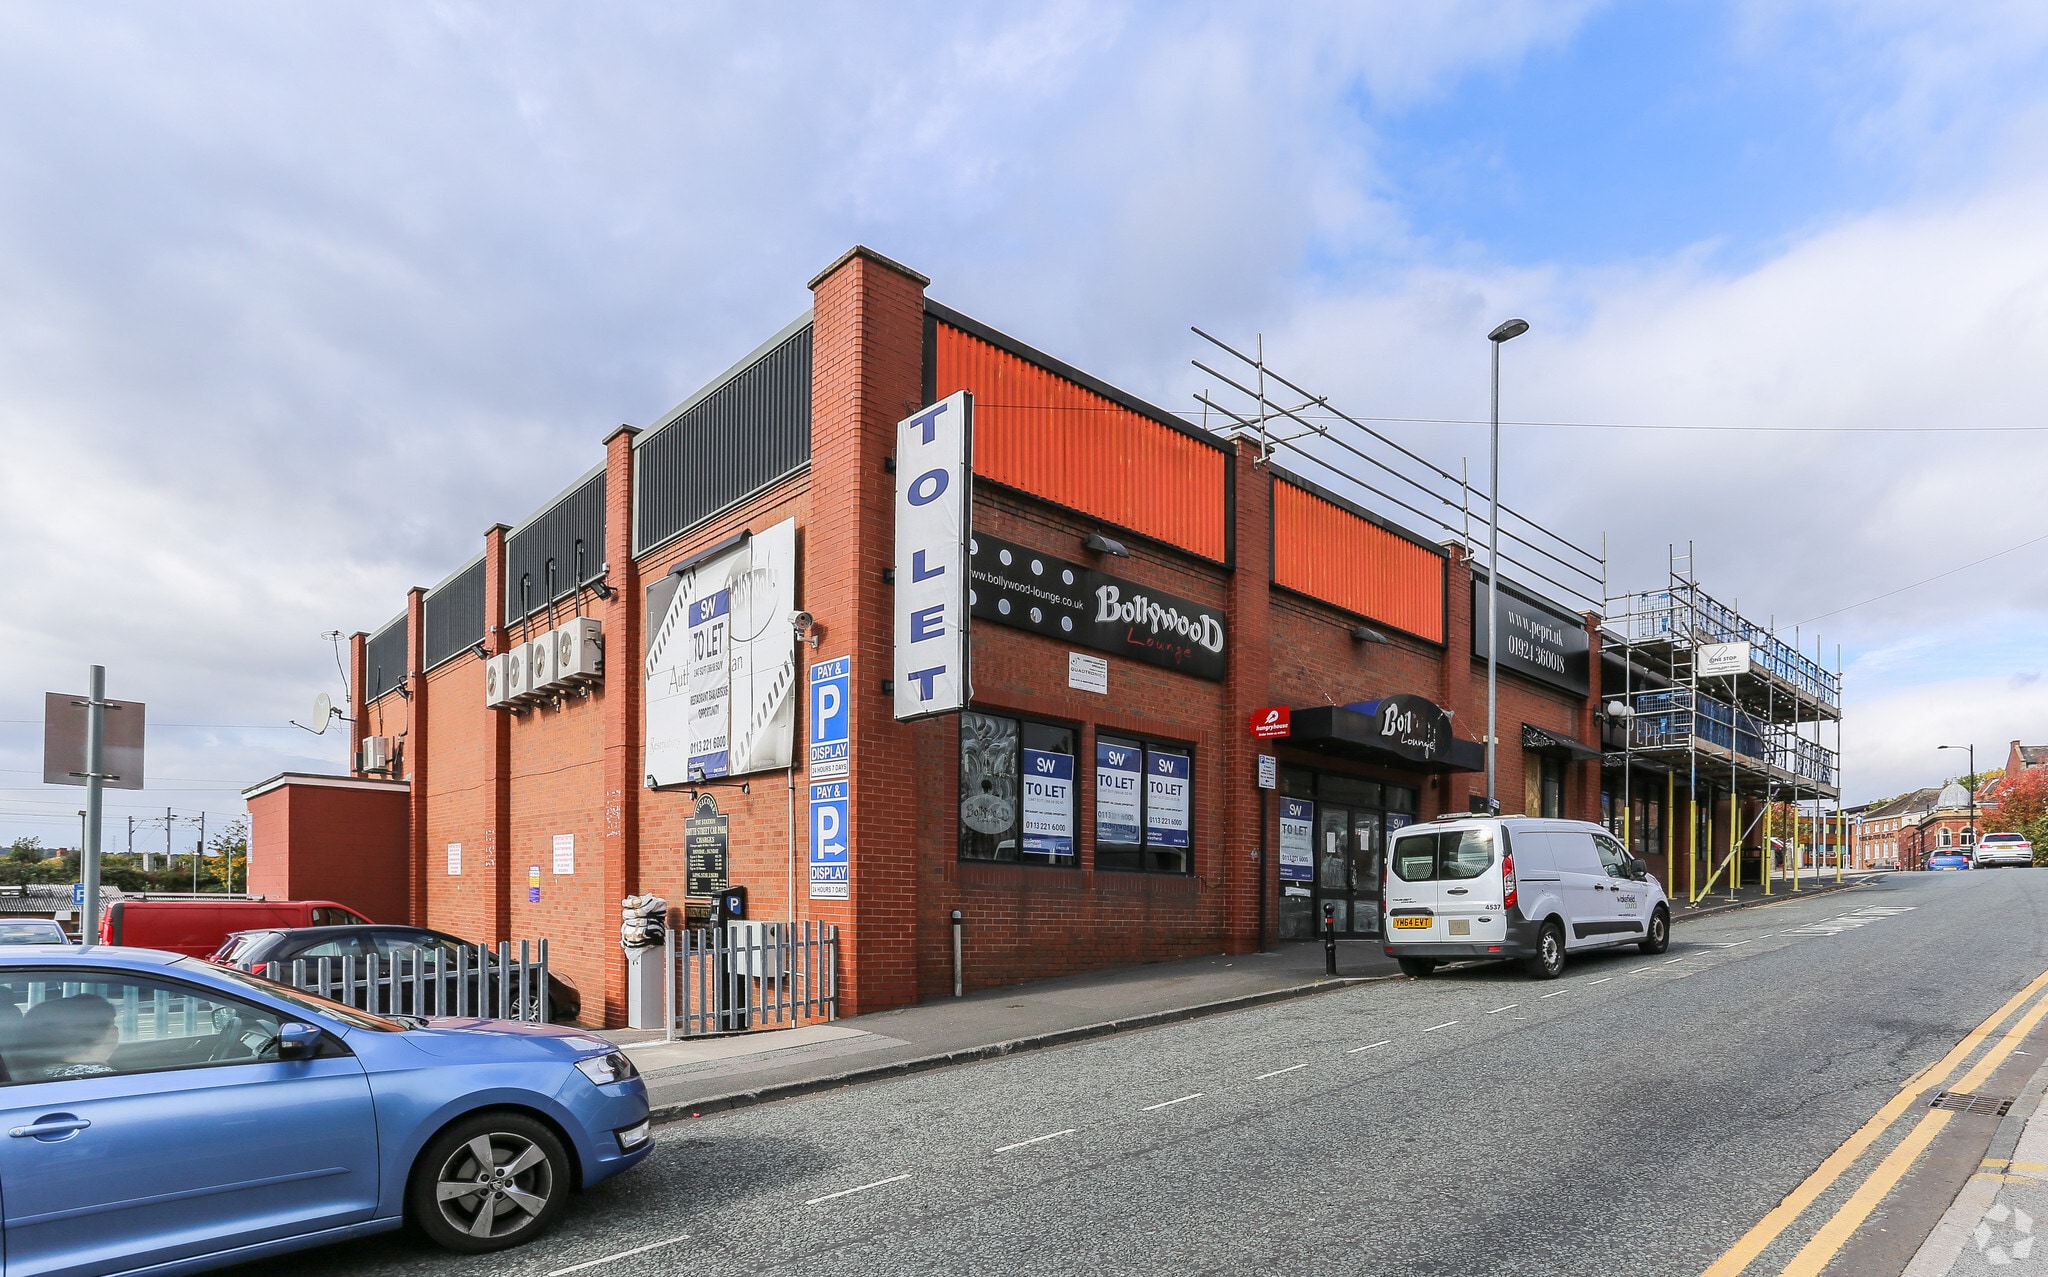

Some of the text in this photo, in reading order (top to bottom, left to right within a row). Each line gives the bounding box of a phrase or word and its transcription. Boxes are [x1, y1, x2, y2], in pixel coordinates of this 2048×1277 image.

[970, 569, 1084, 610] ww.bollywood-lounge.co.uk
[701, 596, 716, 620] SW
[1508, 611, 1563, 647] www.pepri.uk
[694, 622, 723, 662] TO LET
[1127, 627, 1192, 664] Lounge
[1508, 634, 1564, 673] 01924 360018
[817, 662, 841, 679] PAY &
[818, 684, 840, 740] P
[1256, 723, 1288, 731] hungryhouse
[703, 739, 712, 751] 221
[812, 744, 846, 760] DISPLAY
[1401, 733, 1435, 759] Lounge
[1037, 757, 1055, 773] SW
[1108, 751, 1125, 766] SW
[1158, 759, 1174, 773] SW
[817, 765, 831, 773] HOURS
[836, 763, 846, 771] DAYS
[1098, 774, 1134, 790] TO LET
[1149, 781, 1183, 796] TO LET
[817, 784, 840, 799] PAY &
[1026, 782, 1066, 799] TO LET
[1098, 811, 1111, 819] 0113
[1289, 804, 1302, 816] SW
[1026, 821, 1040, 829] 0113
[1041, 822, 1050, 831] 221
[1161, 817, 1170, 825] 221
[1171, 818, 1182, 826] 6000
[818, 806, 840, 860] P
[1282, 823, 1308, 837] TO LET
[811, 867, 846, 879] DISPLAY
[730, 898, 739, 911] P
[1415, 918, 1428, 926] EVT
